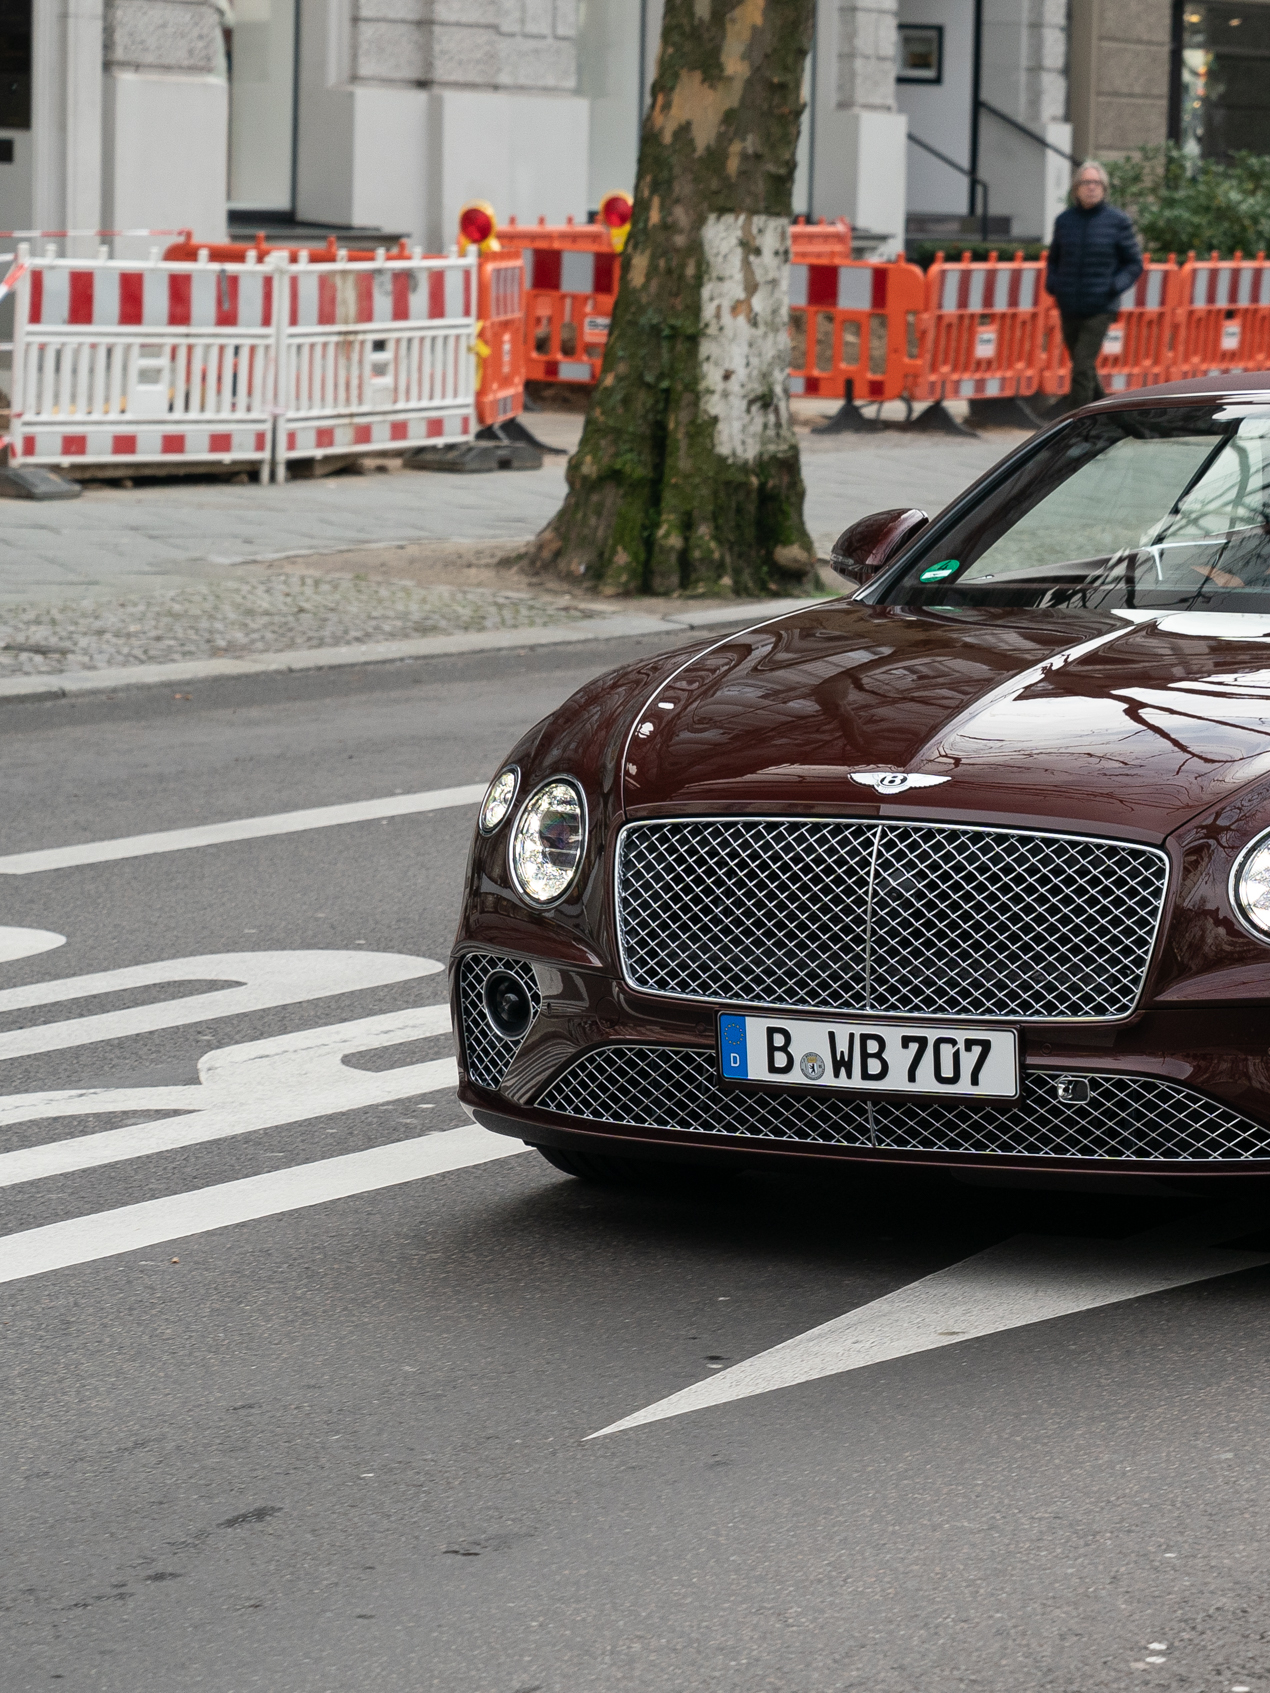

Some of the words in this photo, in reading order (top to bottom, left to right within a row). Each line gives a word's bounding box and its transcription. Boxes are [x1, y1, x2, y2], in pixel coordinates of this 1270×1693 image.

[730, 1053, 740, 1067] D
[766, 1026, 794, 1074] B
[828, 1031, 889, 1081] WB
[901, 1035, 992, 1086] 707
